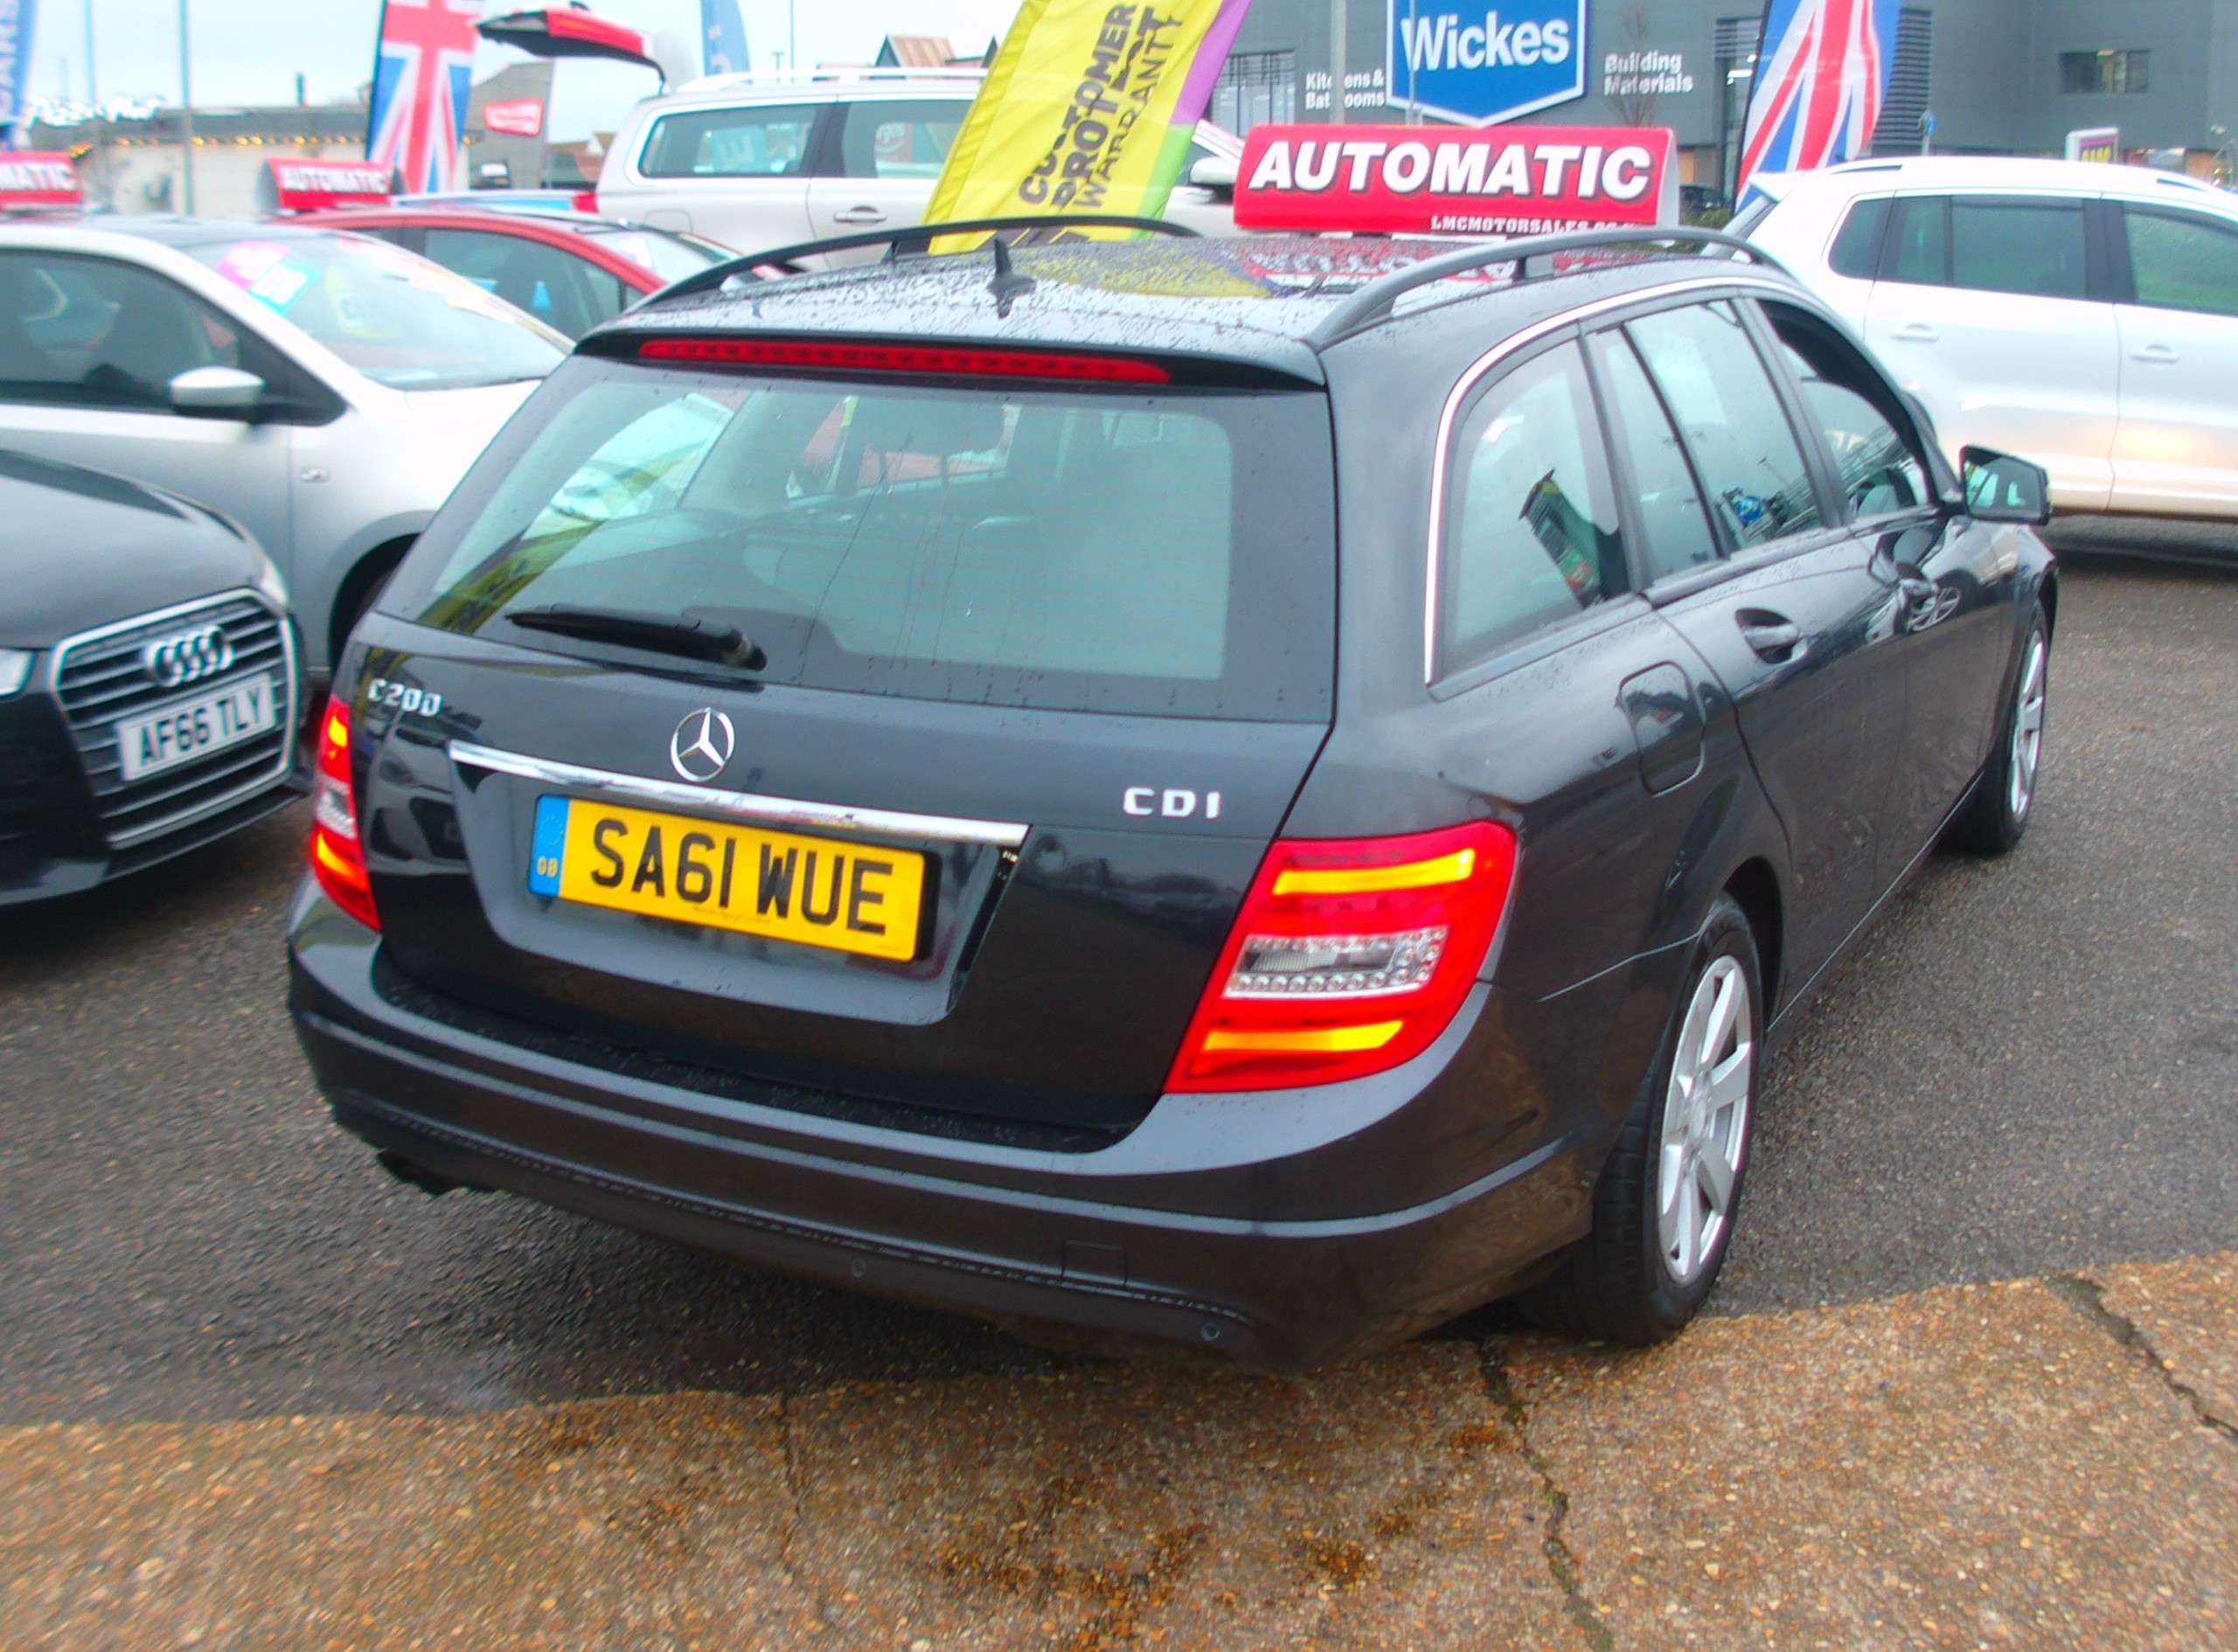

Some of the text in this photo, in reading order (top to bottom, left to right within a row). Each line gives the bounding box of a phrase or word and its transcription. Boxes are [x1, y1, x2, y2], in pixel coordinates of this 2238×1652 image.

[1400, 10, 1570, 72] Wickes
[1605, 50, 1683, 74] Building
[1306, 68, 1386, 91] Kitcens &
[1306, 92, 1386, 110] Batooms
[1604, 73, 1693, 96] Materials
[1018, 4, 1137, 205] CUTOMER
[1051, 6, 1155, 207] PROTT
[280, 166, 388, 194] AUTOMATIC
[1248, 141, 1651, 200] AUTOMATIC
[139, 687, 263, 767] AF66 TLY
[1123, 787, 1220, 819] CDI
[590, 817, 893, 936] SA61 WUE
